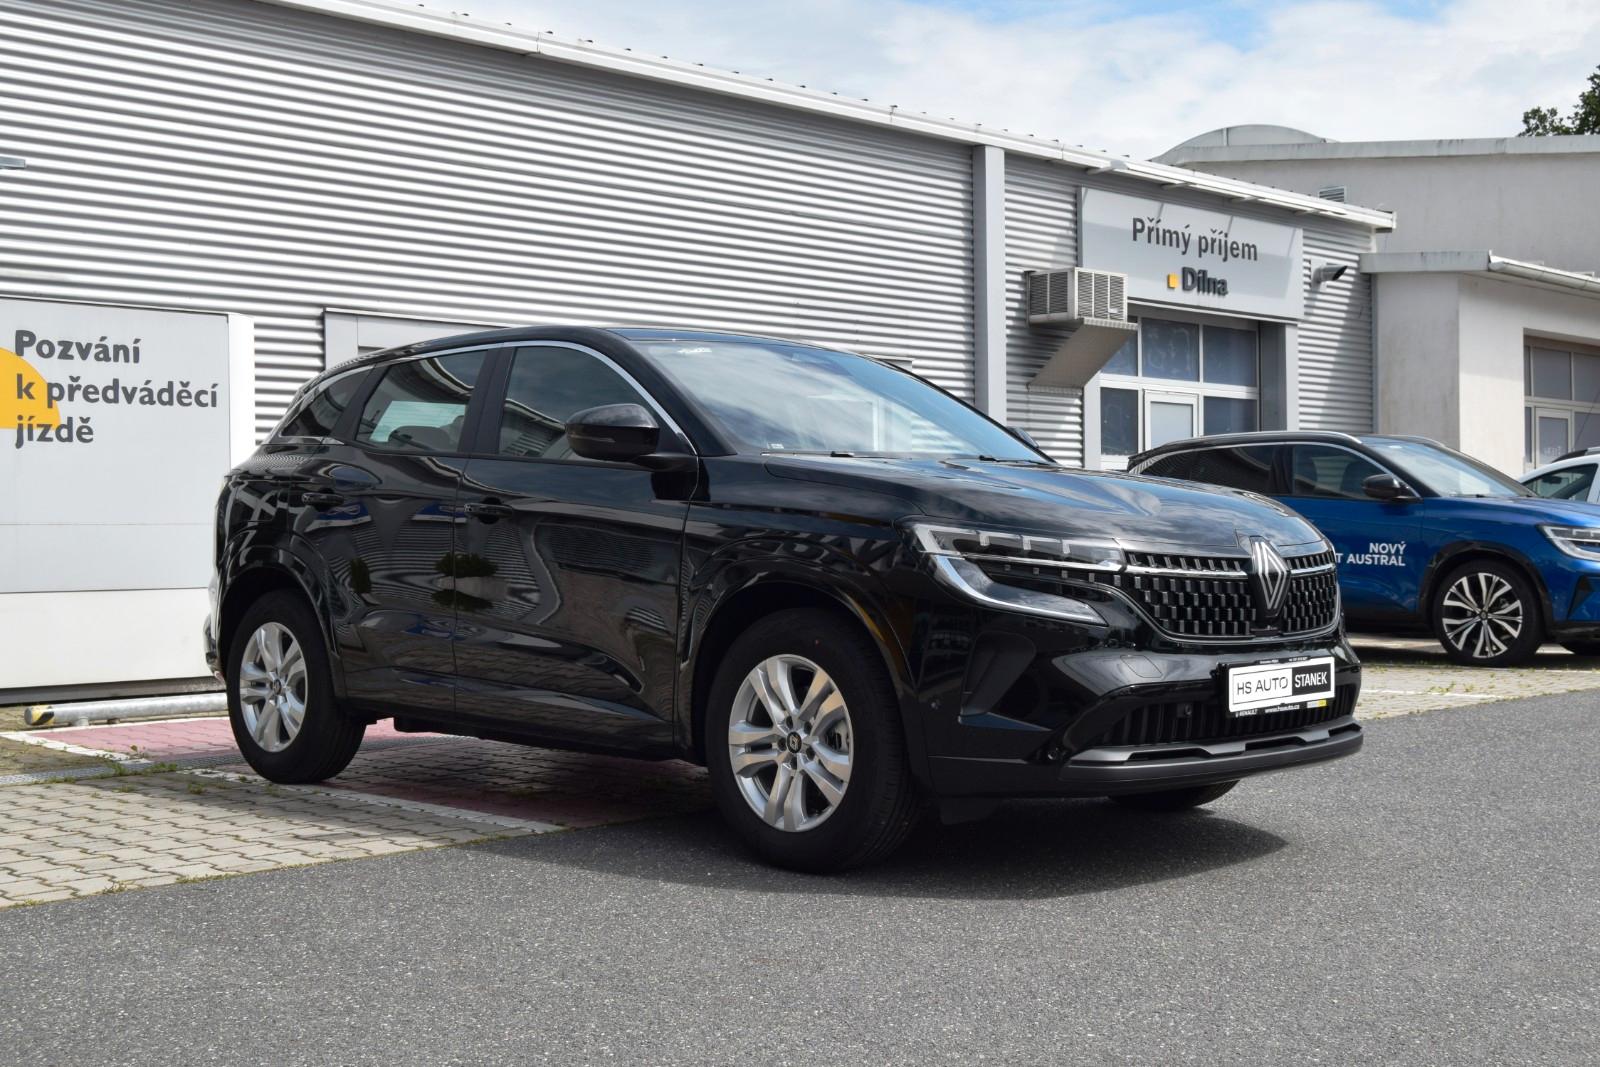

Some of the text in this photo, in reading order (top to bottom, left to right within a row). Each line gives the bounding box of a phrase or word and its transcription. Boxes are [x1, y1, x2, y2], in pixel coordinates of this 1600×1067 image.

[1132, 217, 1258, 262] Přímý příjem
[1182, 266, 1228, 296] Dílna
[15, 329, 141, 363] Pozvání
[16, 373, 219, 408] k předváděcí
[15, 414, 94, 449] jízdě
[1346, 553, 1406, 567] AUSTRAL
[1369, 541, 1407, 555] NOVÝ
[1237, 671, 1328, 695] HS AUTO STANEK
